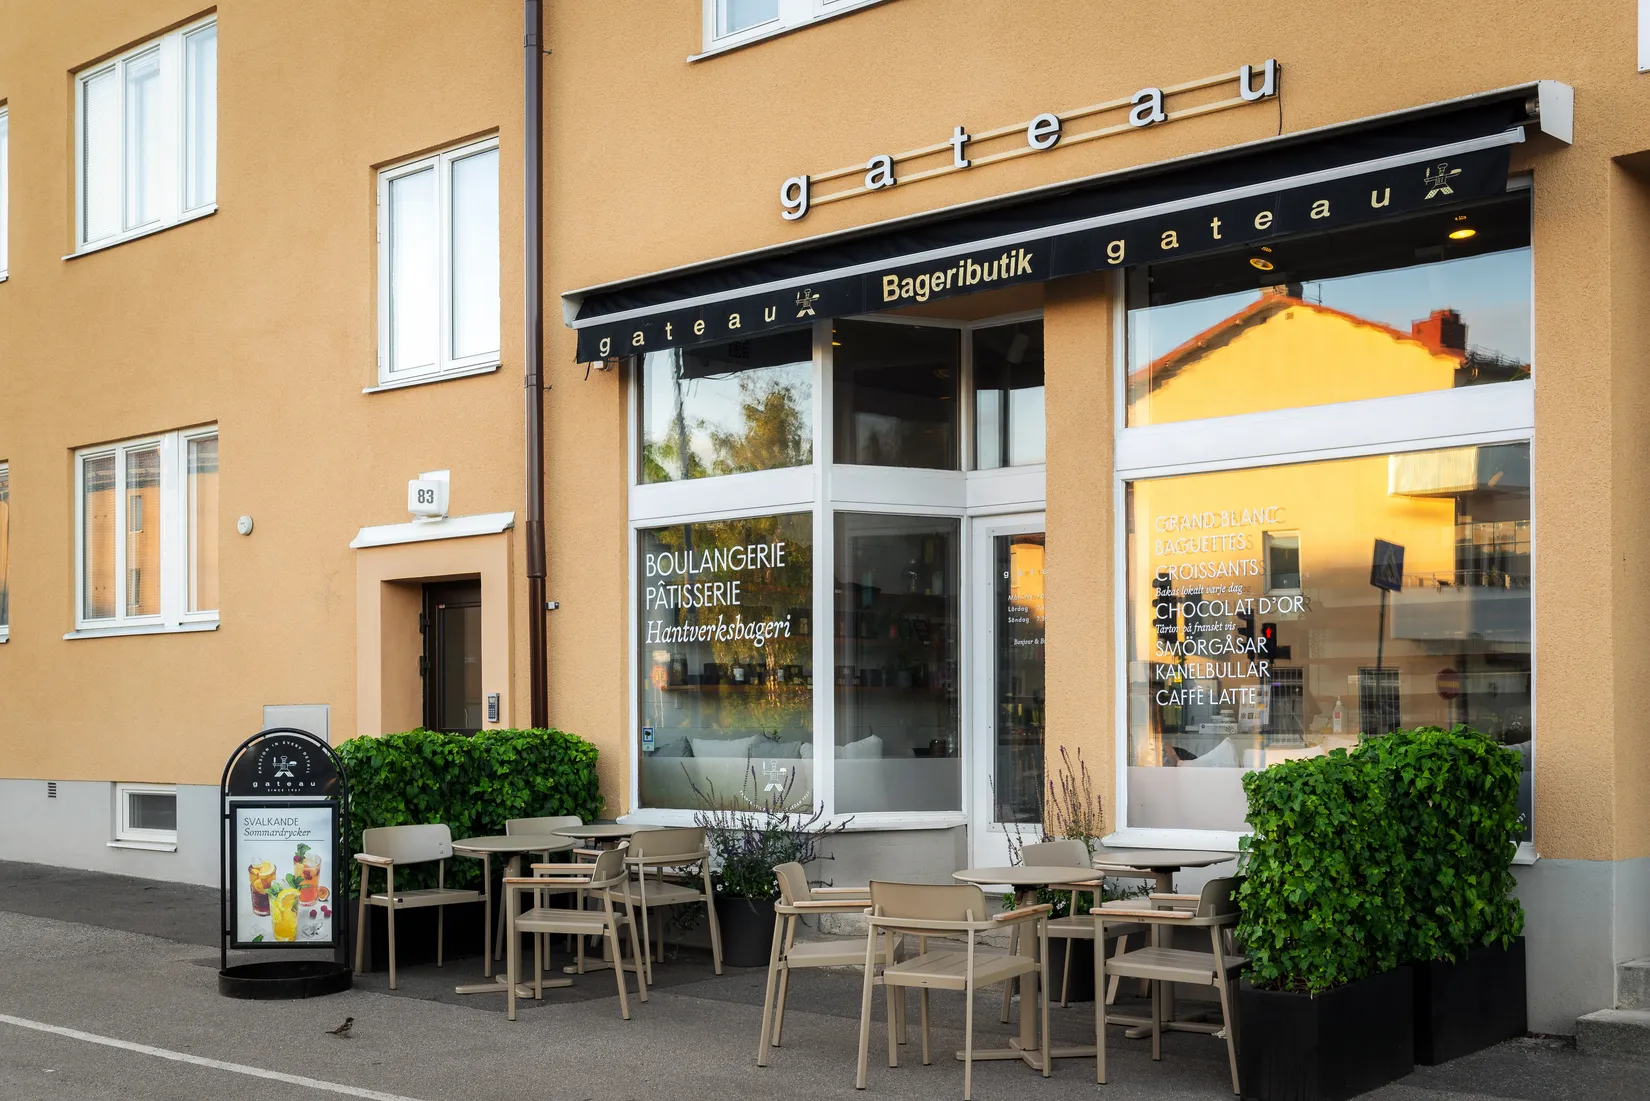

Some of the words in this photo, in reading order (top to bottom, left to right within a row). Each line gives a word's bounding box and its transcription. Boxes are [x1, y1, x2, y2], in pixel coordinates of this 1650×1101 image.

[780, 58, 1277, 220] gateau
[1106, 187, 1391, 264] gateau
[882, 248, 1034, 302] Bageributik
[599, 305, 777, 357] gateau
[417, 488, 434, 504] 83
[1154, 511, 1216, 533] GRAND
[1221, 505, 1279, 527] BLANC
[1154, 532, 1247, 557] BAGUETTES
[646, 542, 785, 577] BOULANGERIE
[1154, 558, 1259, 582] CROISSANTS
[646, 580, 741, 611] PÂTISSERIE
[1155, 585, 1180, 597] Bakas
[1181, 583, 1205, 596] lokalt
[1206, 583, 1227, 596] varje
[1228, 581, 1243, 594] dag
[1007, 605, 1029, 613] Lördag
[1155, 597, 1255, 619] CHOCOLAT
[645, 614, 791, 647] Hantverksbageri
[1007, 616, 1030, 624] Söndag
[1182, 622, 1192, 635] på
[1191, 620, 1222, 635] franskt
[1224, 620, 1236, 631] vis
[1155, 634, 1269, 657] SMÖRGÅSAR
[1155, 660, 1271, 680] KANELBULLAR
[1155, 685, 1204, 706] CAFFÈ
[1209, 687, 1257, 705] LATTE
[257, 747, 270, 774] PASSION
[282, 740, 302, 750] EVERY
[302, 751, 311, 774] DETAIL
[243, 817, 299, 827] SVALKANDE
[243, 827, 312, 840] Sommardrycker
